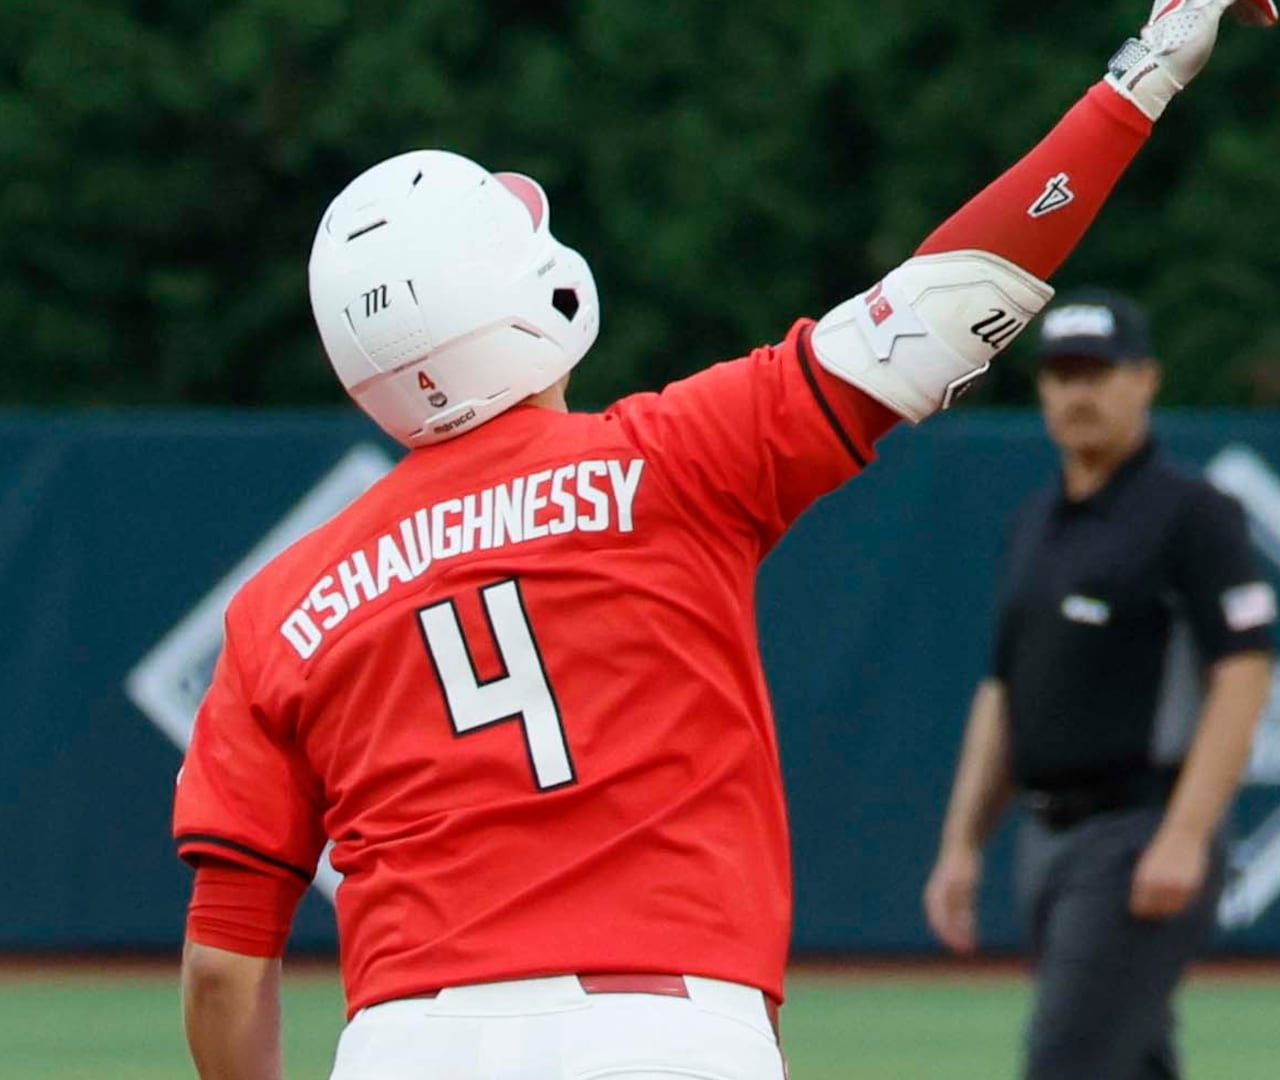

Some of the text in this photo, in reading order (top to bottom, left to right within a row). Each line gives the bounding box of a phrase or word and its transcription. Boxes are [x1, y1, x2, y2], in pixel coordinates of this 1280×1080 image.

[1027, 172, 1074, 217] 4
[418, 370, 435, 390] 4
[280, 458, 645, 660] O'SHAUGHNESSY
[414, 576, 578, 793] 4
